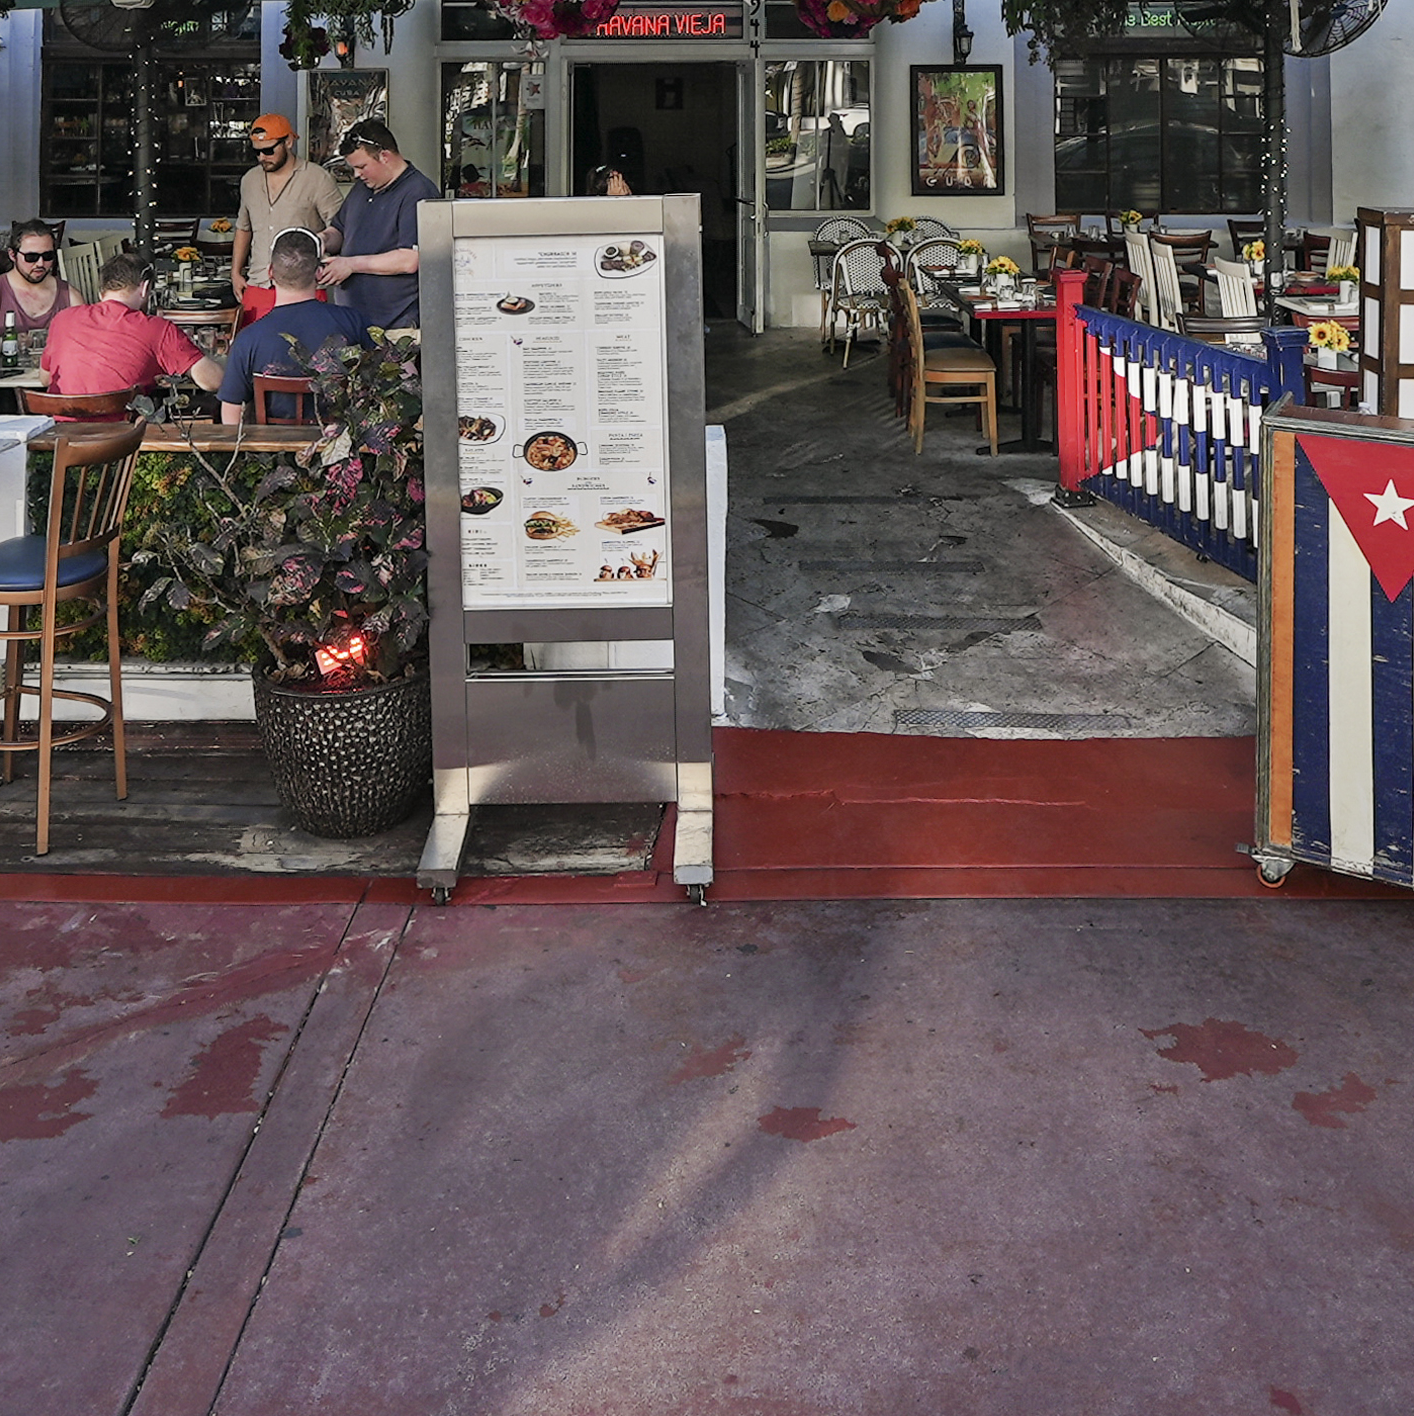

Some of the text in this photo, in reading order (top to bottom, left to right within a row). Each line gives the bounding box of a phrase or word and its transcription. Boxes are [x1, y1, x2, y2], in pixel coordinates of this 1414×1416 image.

[596, 13, 726, 36] HAVANA VIEJA
[1140, 10, 1173, 27] Best
